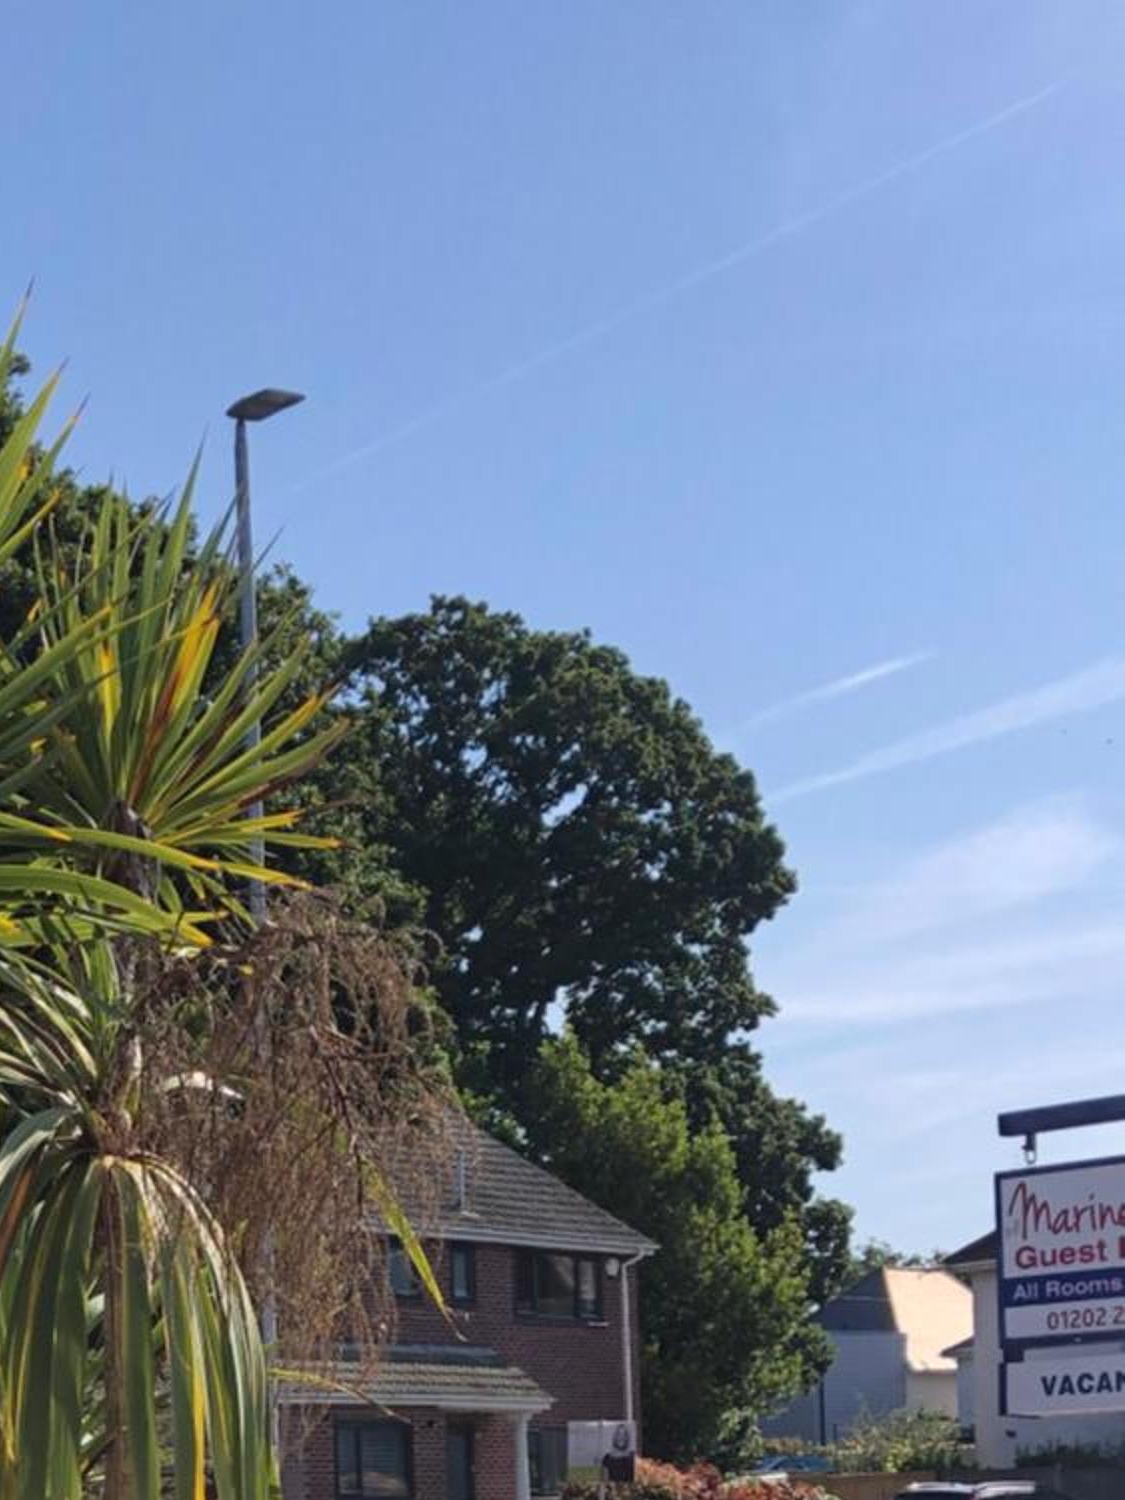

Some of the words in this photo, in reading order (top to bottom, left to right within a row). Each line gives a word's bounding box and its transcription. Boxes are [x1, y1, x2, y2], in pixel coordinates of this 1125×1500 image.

[1016, 1240, 1108, 1269] Guest
[1013, 1281, 1039, 1300] All
[1046, 1277, 1123, 1297] Rooms
[1047, 1307, 1107, 1330] 01202
